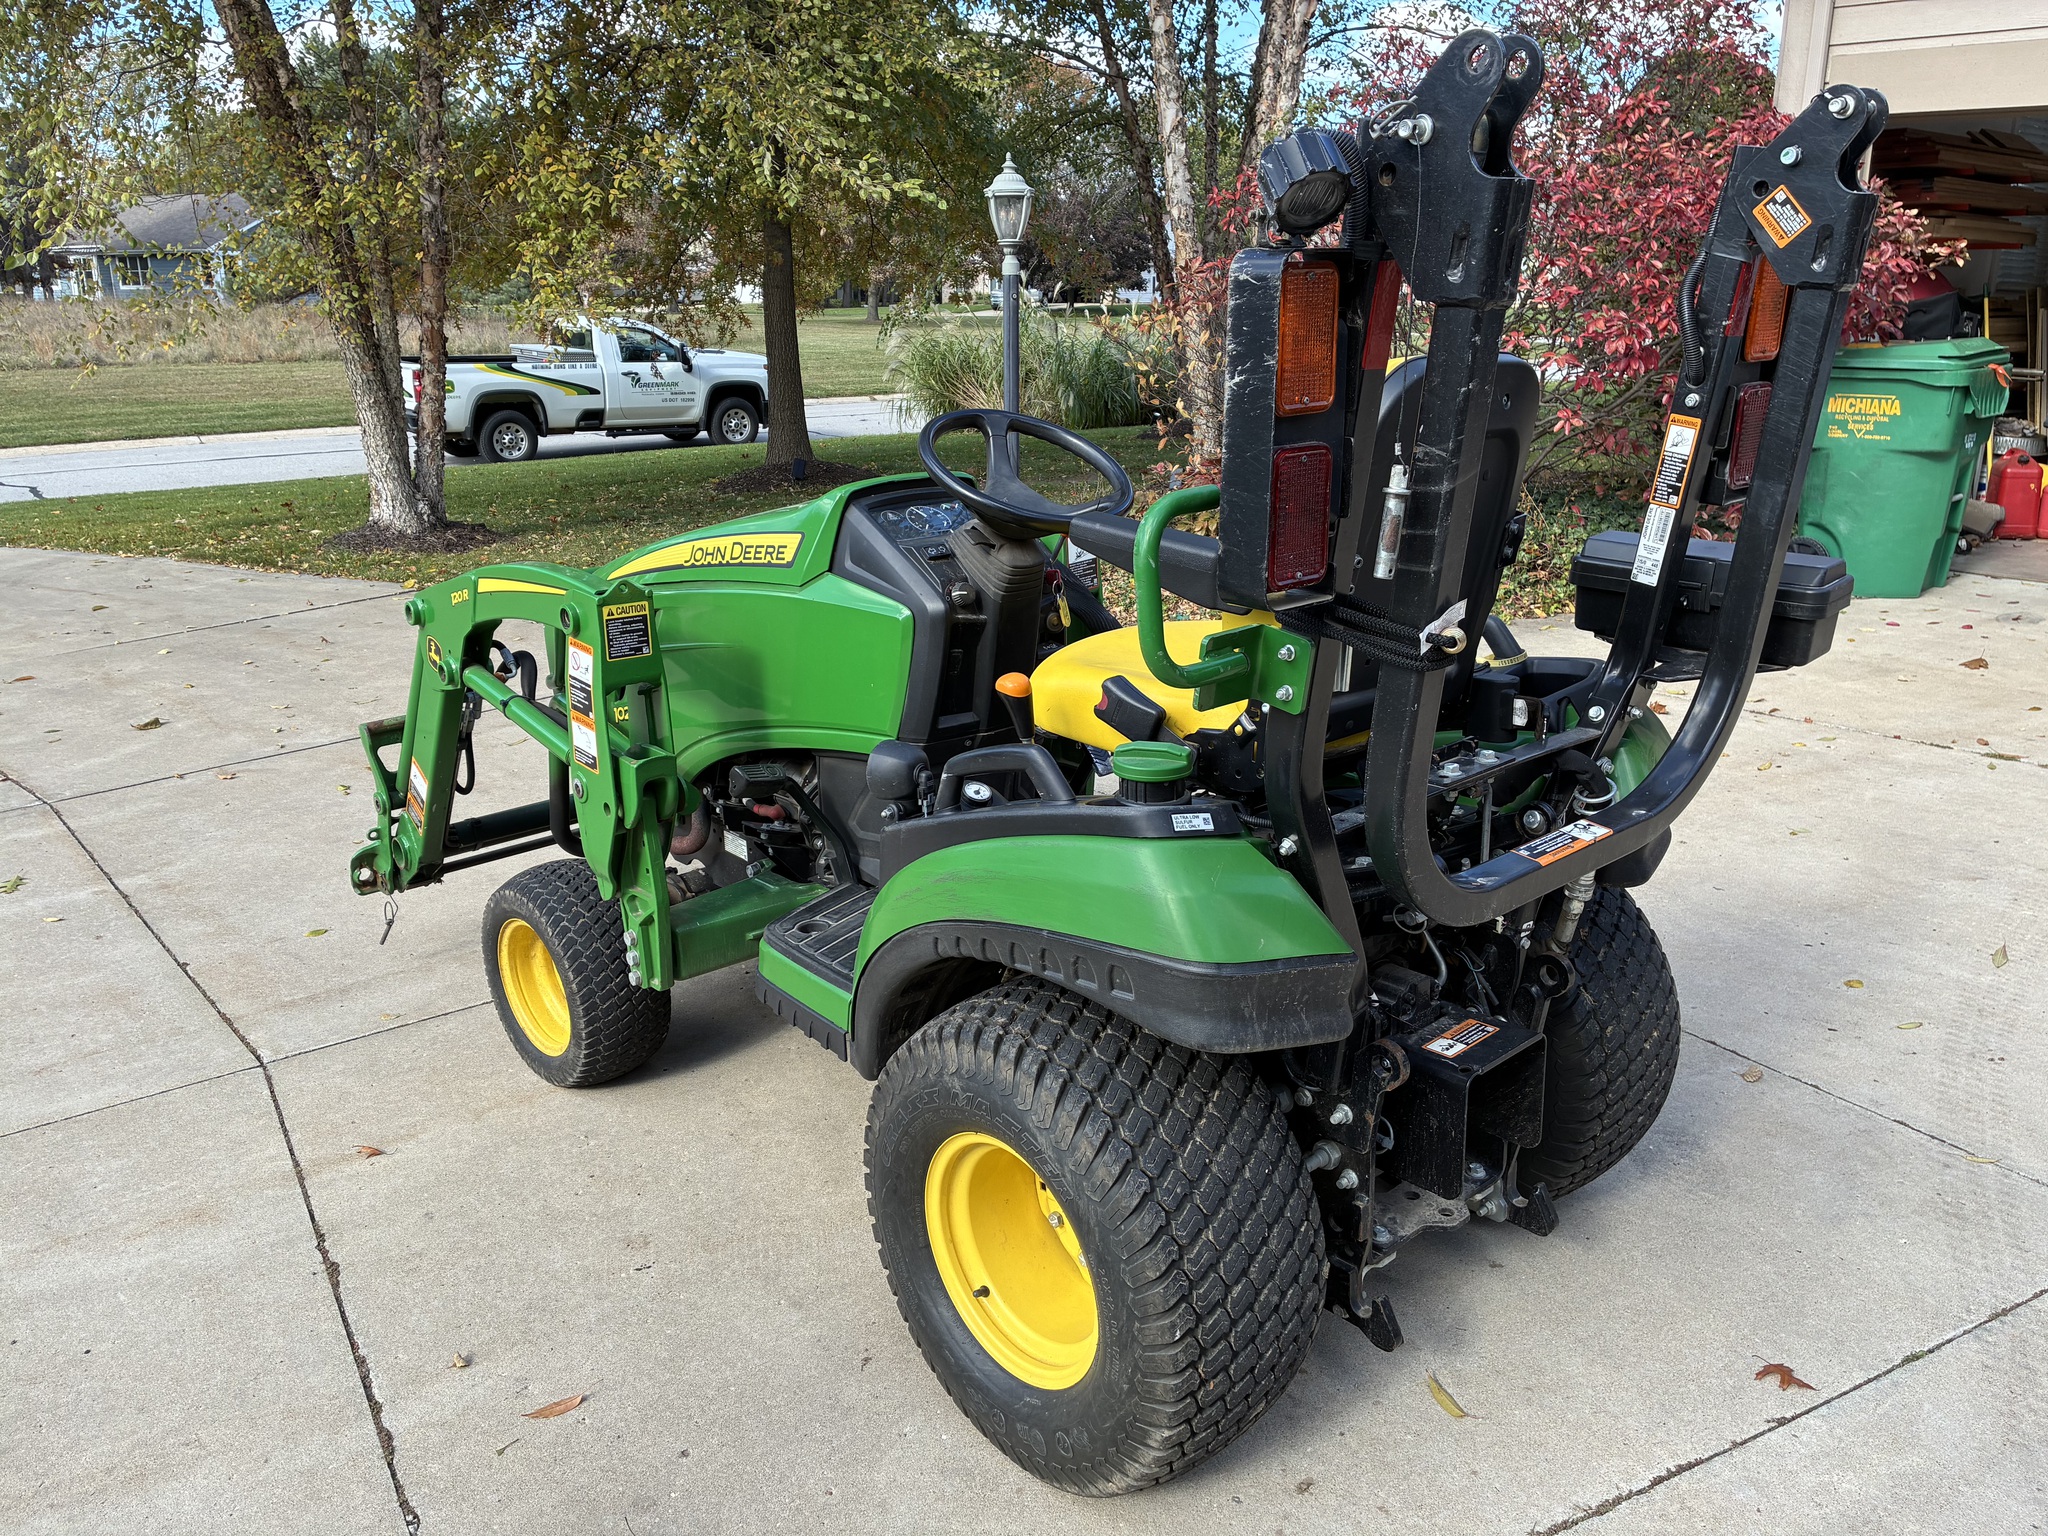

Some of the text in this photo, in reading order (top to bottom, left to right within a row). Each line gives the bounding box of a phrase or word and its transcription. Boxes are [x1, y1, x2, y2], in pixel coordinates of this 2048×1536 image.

[1757, 208, 1780, 237] WARNING
[638, 381, 680, 389] GREENMARK
[1827, 397, 1901, 416] MICHIANA
[1676, 418, 1699, 428] WARNING
[1835, 413, 1861, 421] RECYCLING
[1847, 423, 1874, 431] SERVICES
[684, 541, 788, 564] JOHN DEERE
[615, 603, 647, 616] CAUTION
[573, 641, 592, 655] WARNING
[951, 1089, 1074, 1202] MASTER
